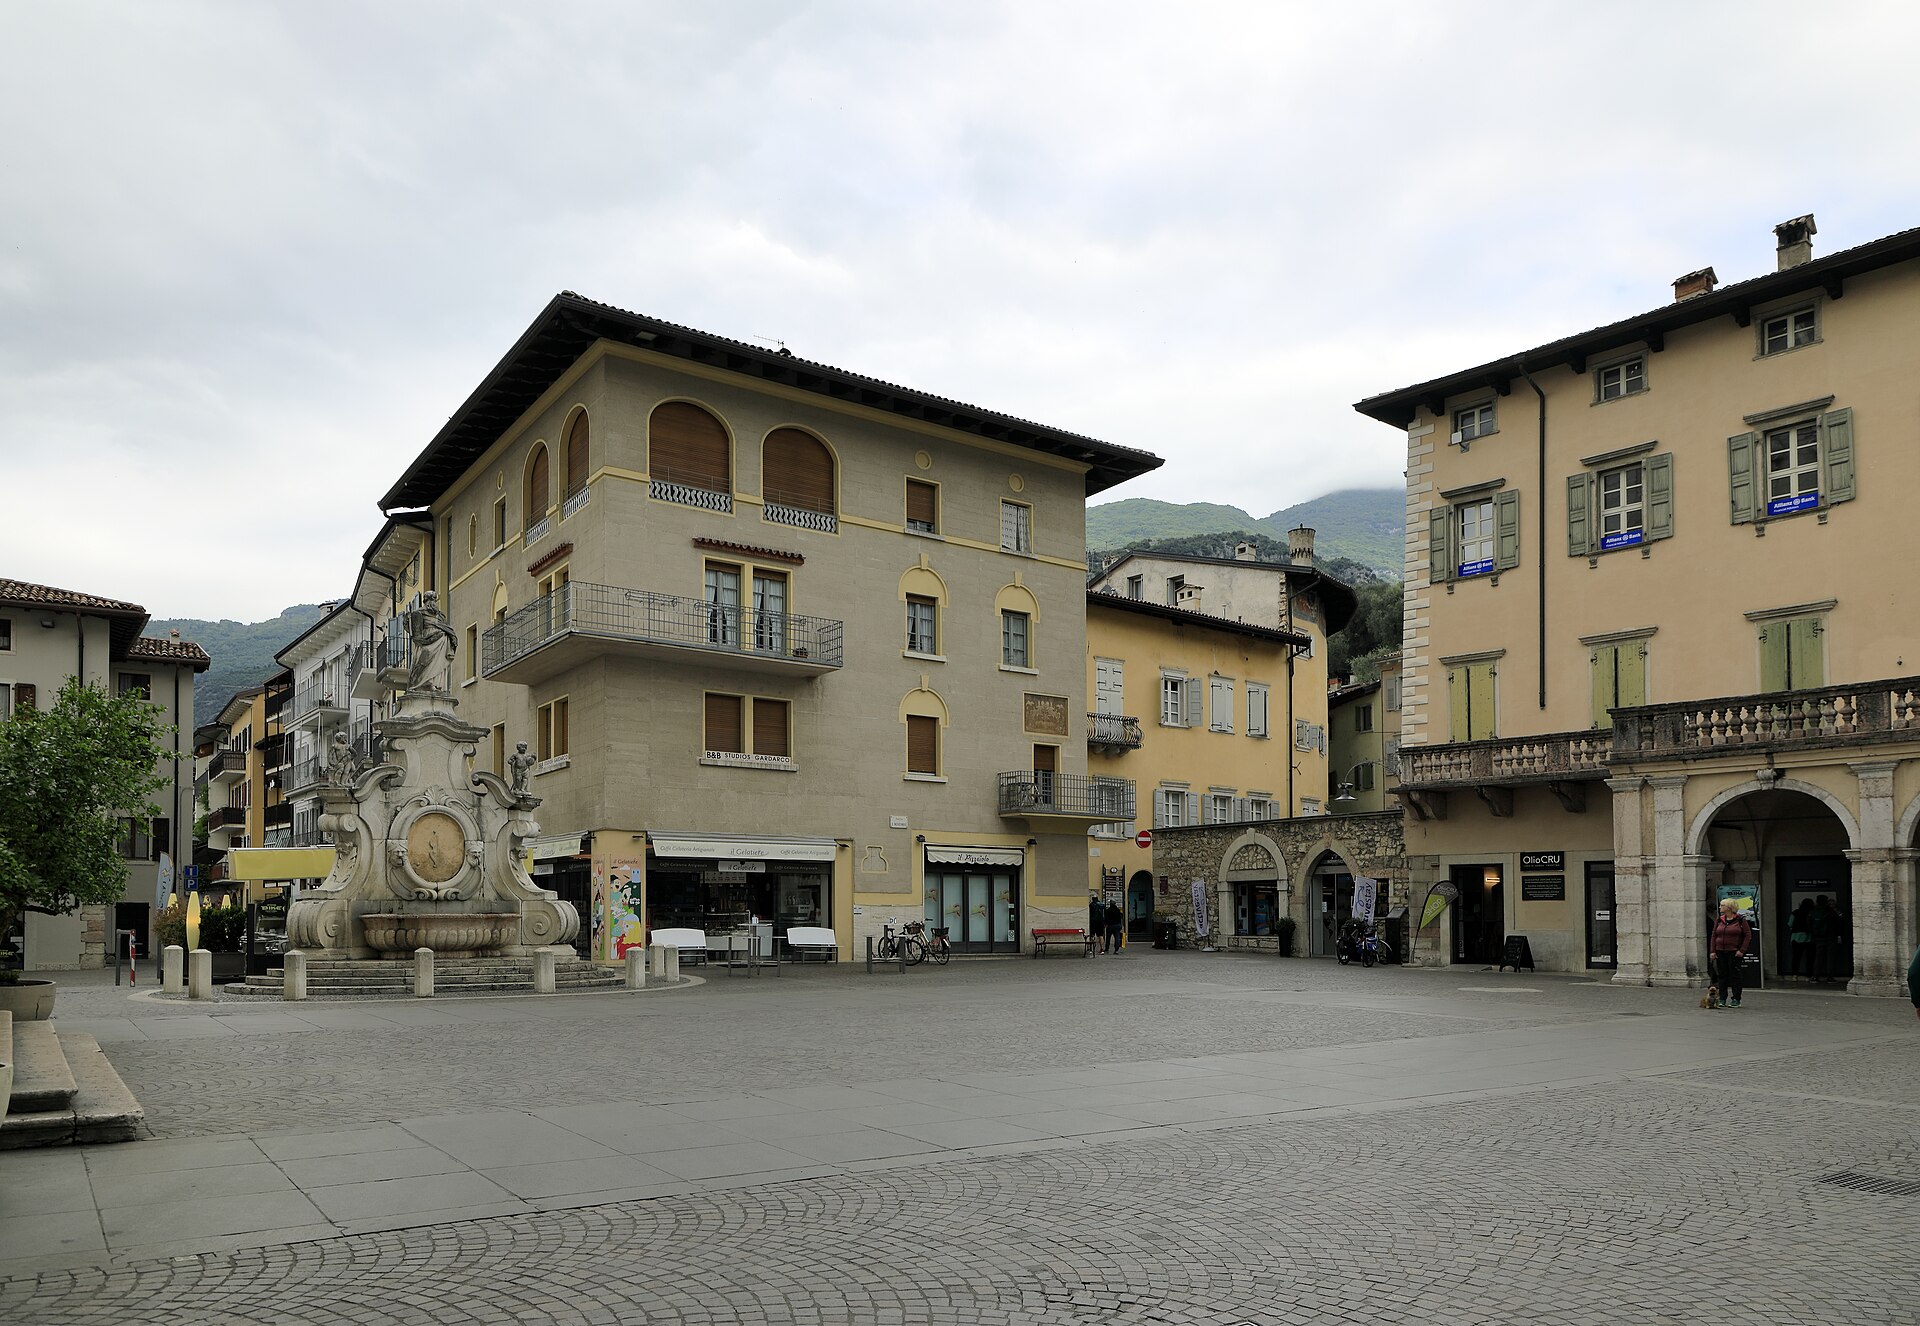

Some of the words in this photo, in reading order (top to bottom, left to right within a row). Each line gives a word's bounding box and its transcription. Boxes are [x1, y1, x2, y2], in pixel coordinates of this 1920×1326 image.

[1773, 501, 1793, 509] Allianz
[706, 751, 722, 759] B&B
[724, 752, 751, 760] STUDIOS
[754, 755, 790, 763] GARDARCO
[692, 846, 715, 854] Artigianale
[730, 848, 735, 856] il
[957, 853, 963, 861] il
[1522, 855, 1561, 865] OlioCRU
[187, 879, 195, 889] P
[1363, 882, 1373, 922] tivestay
[1425, 898, 1443, 916] SHOP
